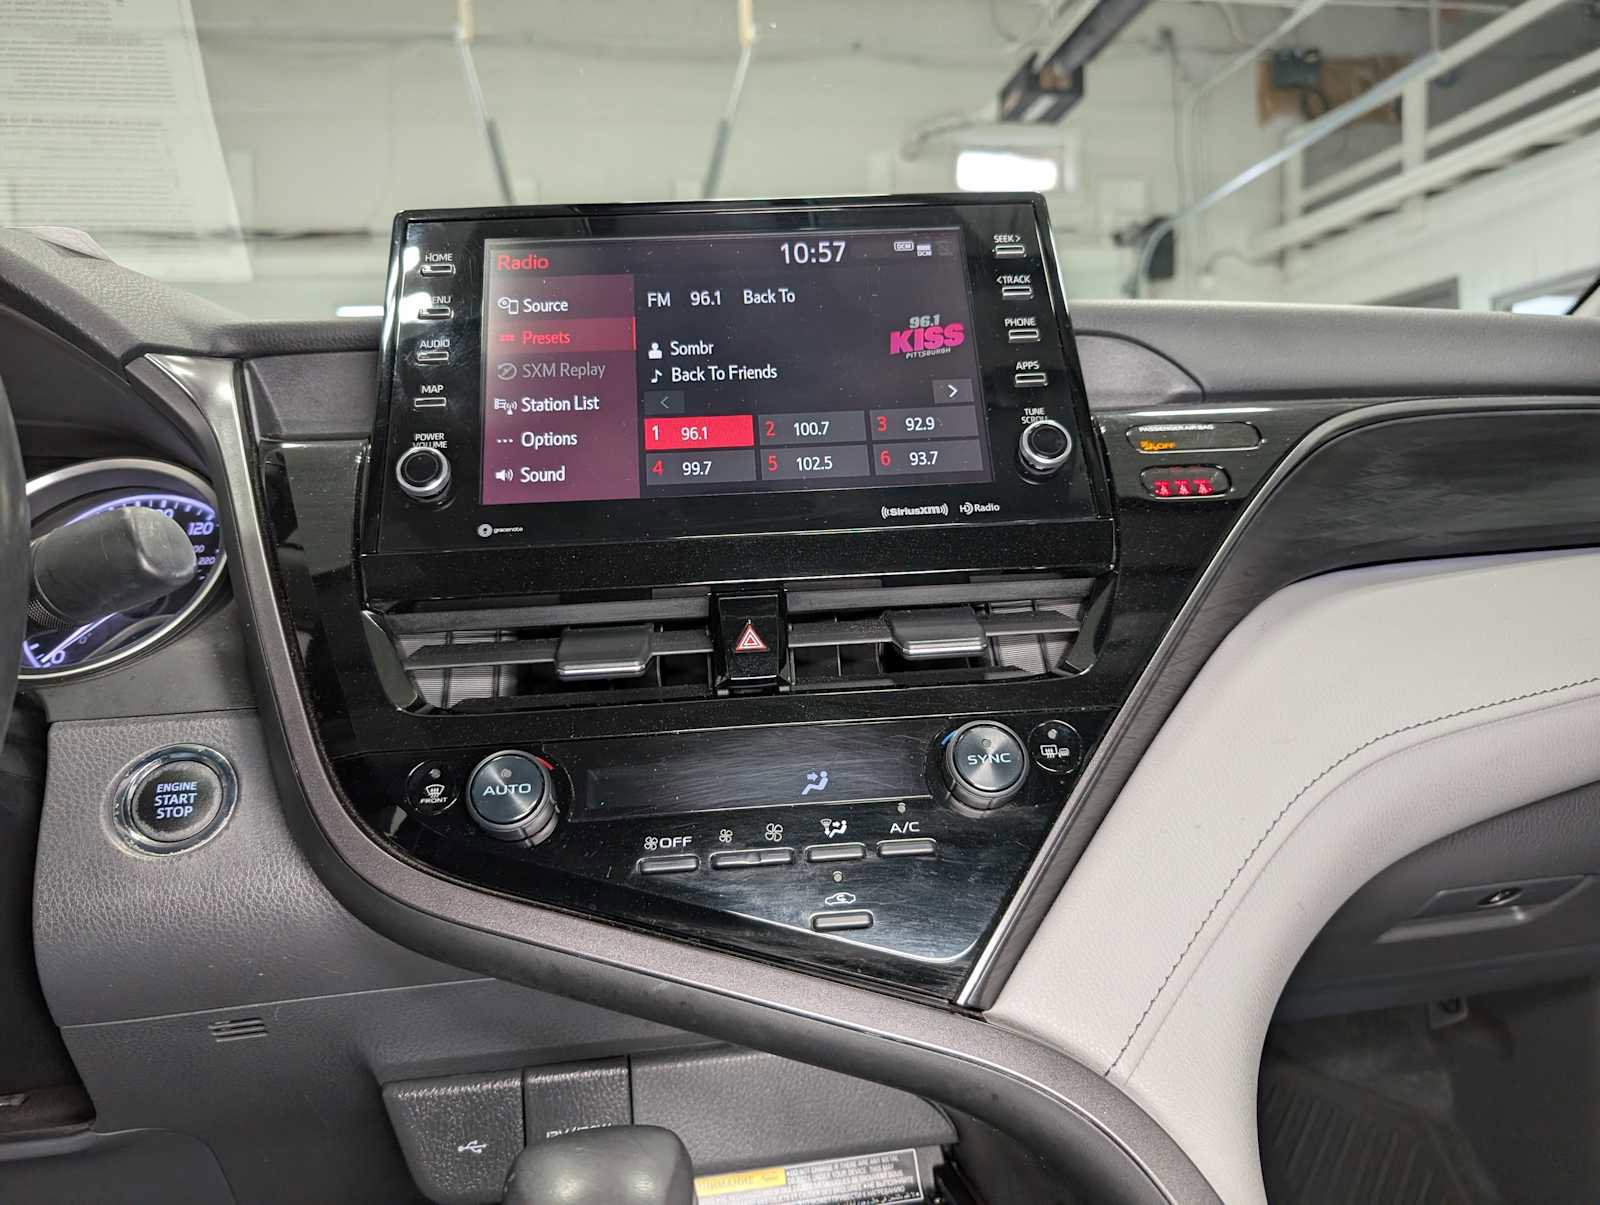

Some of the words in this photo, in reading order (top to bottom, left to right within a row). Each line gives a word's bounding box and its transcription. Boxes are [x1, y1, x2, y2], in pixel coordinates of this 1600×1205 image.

[425, 252, 453, 262] HOME
[780, 241, 846, 264] 10:57
[497, 255, 549, 270] Radio
[427, 294, 452, 304] ENU
[647, 293, 671, 307] FM
[690, 292, 721, 306] 96.1
[743, 290, 776, 305] Back
[778, 289, 795, 303] To
[523, 298, 568, 313] Source
[909, 314, 941, 329] 96.1
[1005, 318, 1036, 327] PHONE
[420, 338, 450, 348] AUDIO
[523, 331, 570, 345] Presets
[889, 323, 965, 355] KISS
[670, 341, 714, 356] Sombr
[905, 348, 951, 359] PITTSBURGH
[523, 364, 556, 377] SXM
[560, 363, 605, 379] Replay
[1016, 361, 1040, 370] APPS
[671, 367, 705, 382] Back
[708, 366, 726, 381] To
[729, 364, 778, 380] Friends
[421, 385, 443, 393] MAP
[521, 399, 571, 412] Station
[575, 396, 600, 411] List
[1024, 407, 1045, 416] TUNE
[765, 422, 776, 437] 2
[793, 422, 830, 436] 100.7
[876, 417, 887, 431] 3
[905, 417, 935, 431] 92.9
[415, 432, 445, 441] POWER
[652, 425, 660, 440] 1
[681, 427, 709, 441] 96.1
[521, 432, 578, 449] Options
[767, 456, 778, 471] 5
[796, 456, 832, 471] 102.5
[880, 451, 891, 466] 6
[909, 451, 938, 466] 93.7
[520, 467, 566, 483] Sound
[652, 461, 663, 476] 4
[682, 461, 712, 476] 99.7
[974, 503, 1000, 513] Radio
[188, 522, 214, 535] 120
[198, 556, 216, 565] 220
[51, 650, 66, 664] 0
[968, 752, 1012, 765] SYNC
[156, 781, 197, 793] ENGINE
[483, 783, 531, 796] AUTO
[154, 793, 196, 807] START
[420, 796, 448, 804] FRONT
[156, 805, 193, 819] STOP
[890, 821, 921, 834] A/C
[659, 836, 692, 848] OFF
